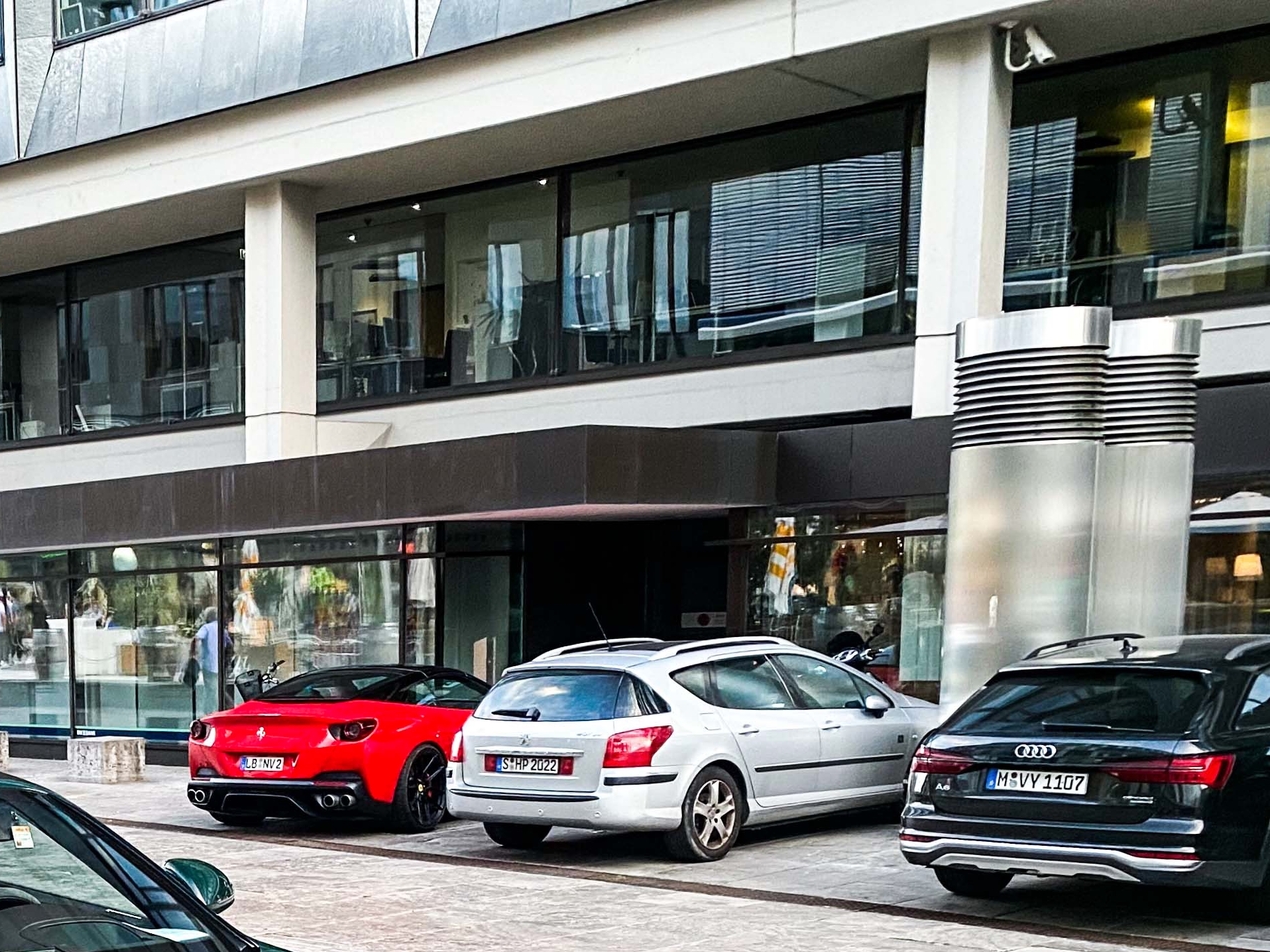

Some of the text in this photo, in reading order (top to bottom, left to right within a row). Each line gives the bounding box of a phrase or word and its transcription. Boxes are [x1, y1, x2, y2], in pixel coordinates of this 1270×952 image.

[515, 759, 529, 771] HP
[530, 759, 557, 772] 2022
[1042, 774, 1085, 792] 1107
